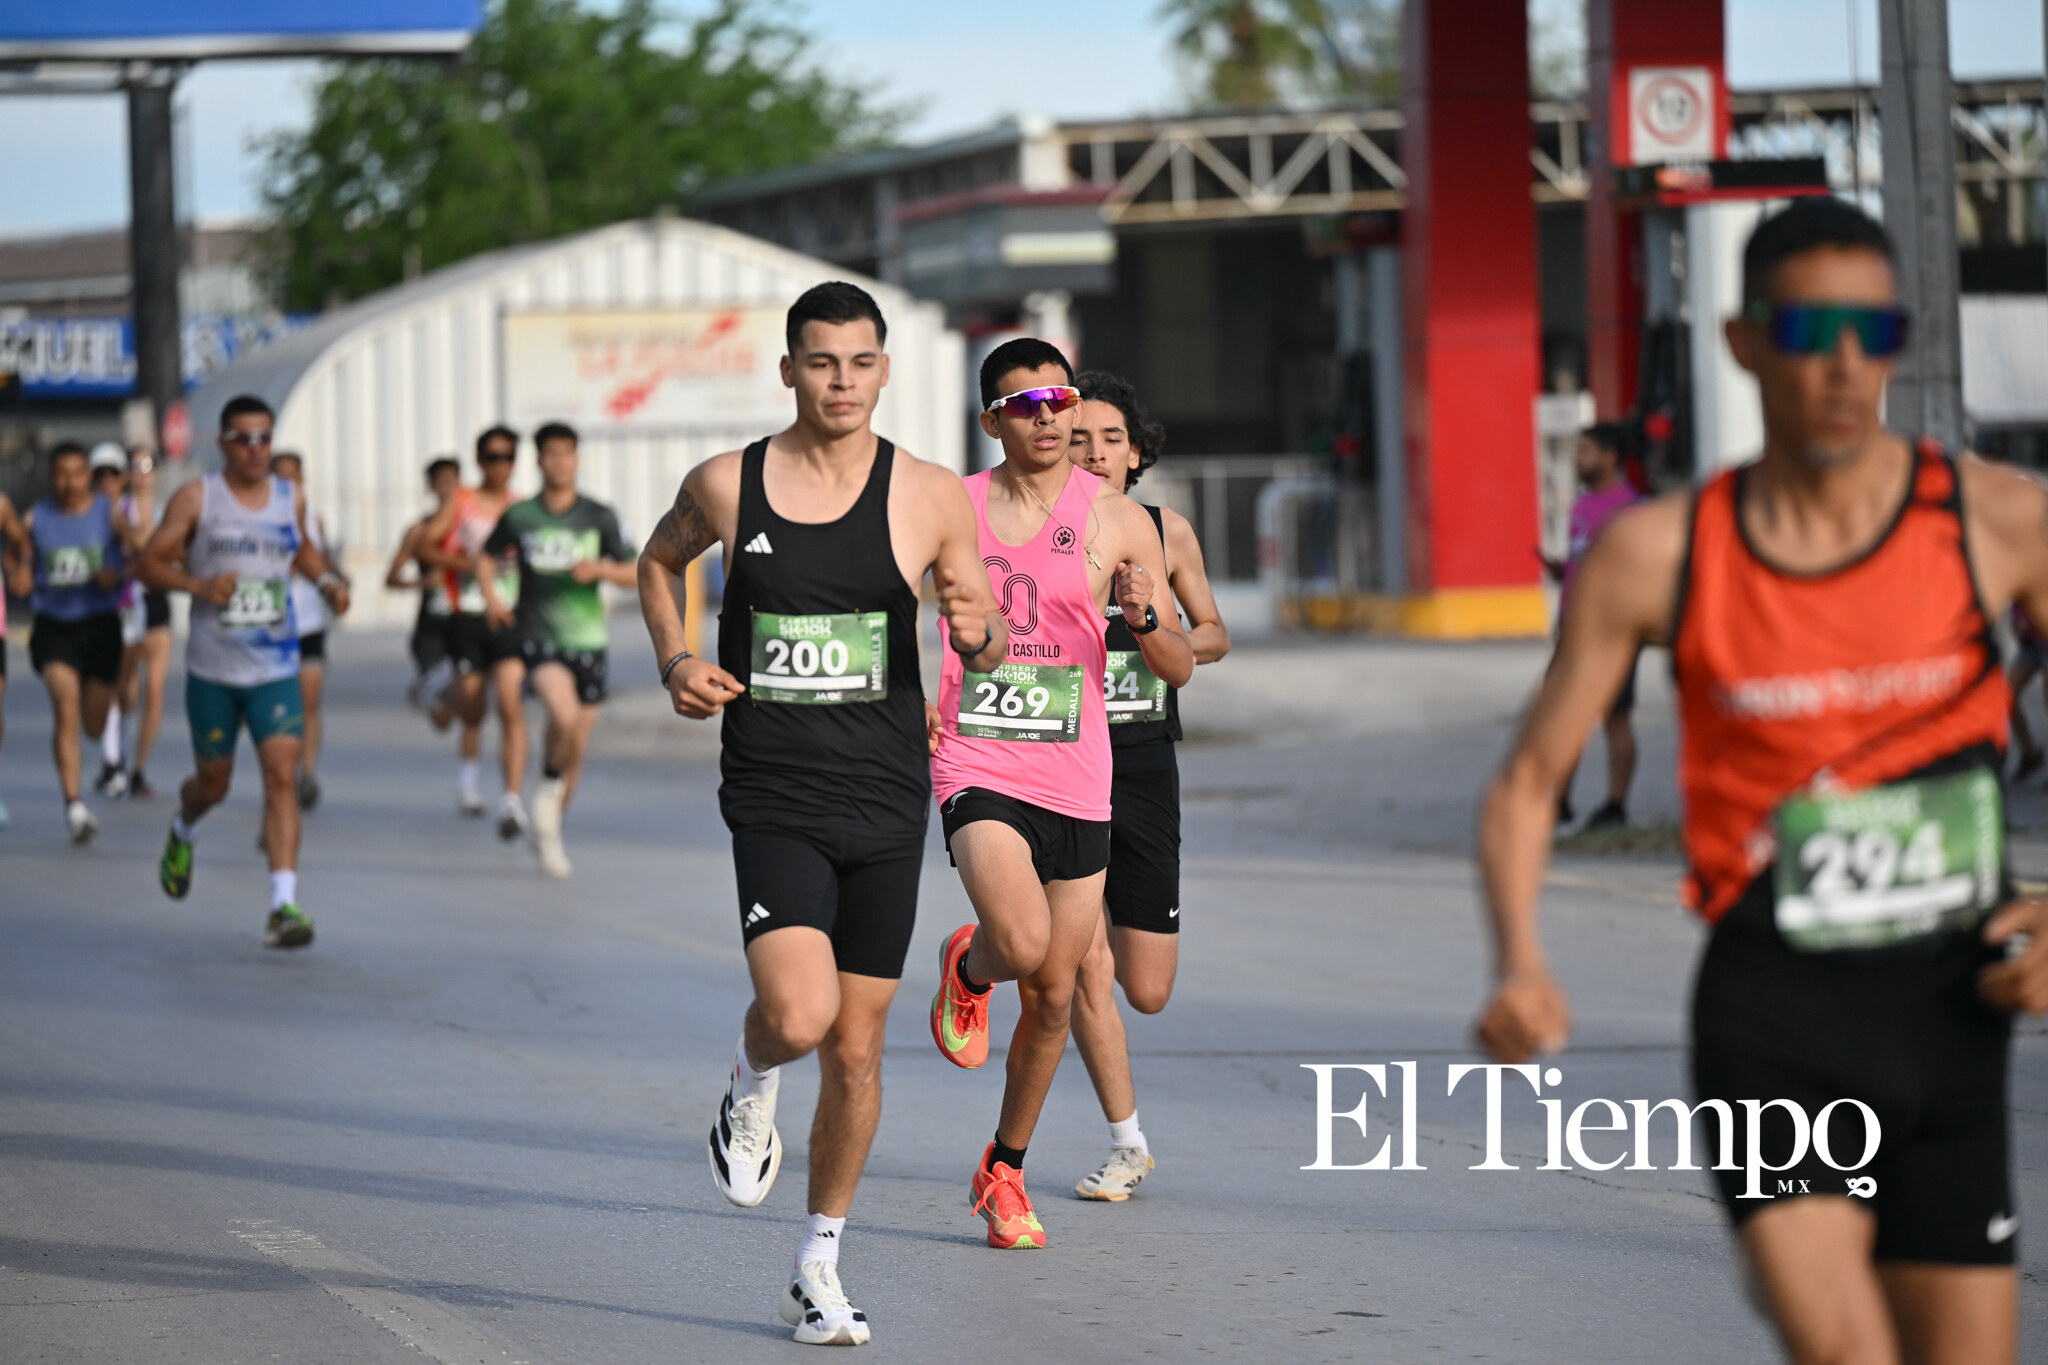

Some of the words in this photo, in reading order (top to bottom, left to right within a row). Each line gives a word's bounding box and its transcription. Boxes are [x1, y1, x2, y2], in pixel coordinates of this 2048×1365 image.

[764, 638, 849, 677] 200
[871, 631, 882, 691] MEDALLA
[998, 663, 1038, 673] ARRERA
[1013, 643, 1060, 658] CASTILLO
[1069, 670, 1082, 678] 269
[973, 681, 1050, 717] 269
[1067, 682, 1080, 734] MEDALLA
[1800, 819, 1948, 898] 294
